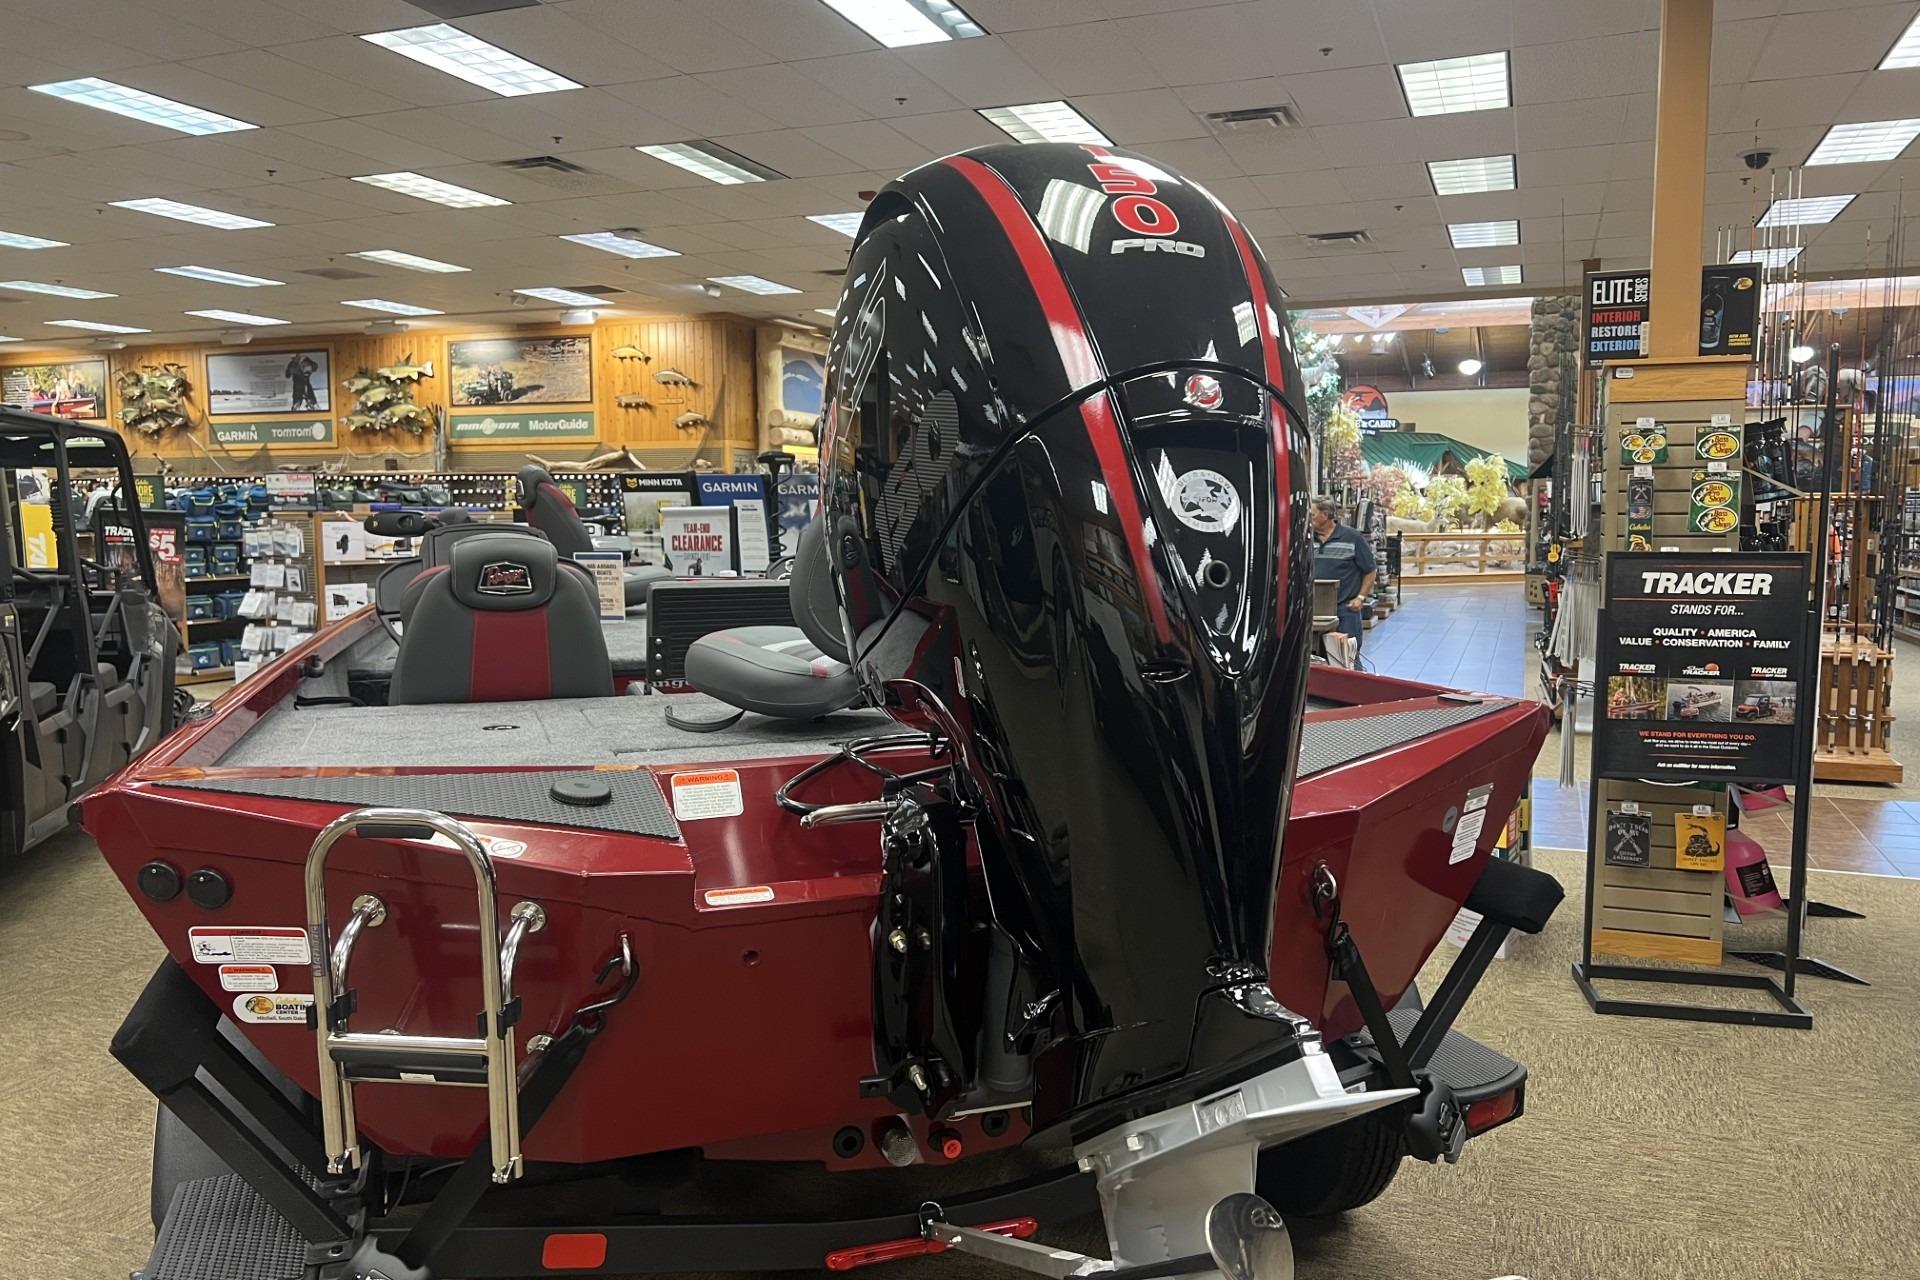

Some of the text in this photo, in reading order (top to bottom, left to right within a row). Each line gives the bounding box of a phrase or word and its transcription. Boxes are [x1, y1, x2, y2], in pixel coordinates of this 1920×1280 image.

[1110, 238, 1206, 258] PRO
[1592, 279, 1634, 305] ELITE
[1634, 277, 1649, 303] SERIES
[1591, 311, 1641, 324] INTERIOR
[529, 418, 589, 431] MotorGuide
[217, 427, 258, 442] GARMIN
[638, 477, 683, 487] MINN KOTA
[702, 481, 758, 493] GARMIN
[683, 523, 711, 533] YEAR-END
[671, 536, 723, 552] CLEARANCE
[1641, 572, 1773, 596] TRACKER
[1670, 604, 1744, 616] STANDS FOR...
[1653, 627, 1757, 639] QUALITY AMERICA
[1619, 637, 1791, 650] VALUE CONSERVATION FAMILY
[1619, 663, 1656, 671] TRACKER
[1751, 666, 1788, 675] TRACKER
[1687, 732, 1728, 740] EVERYTHING
[1729, 733, 1744, 741] YOU
[687, 775, 722, 783] WARNING
